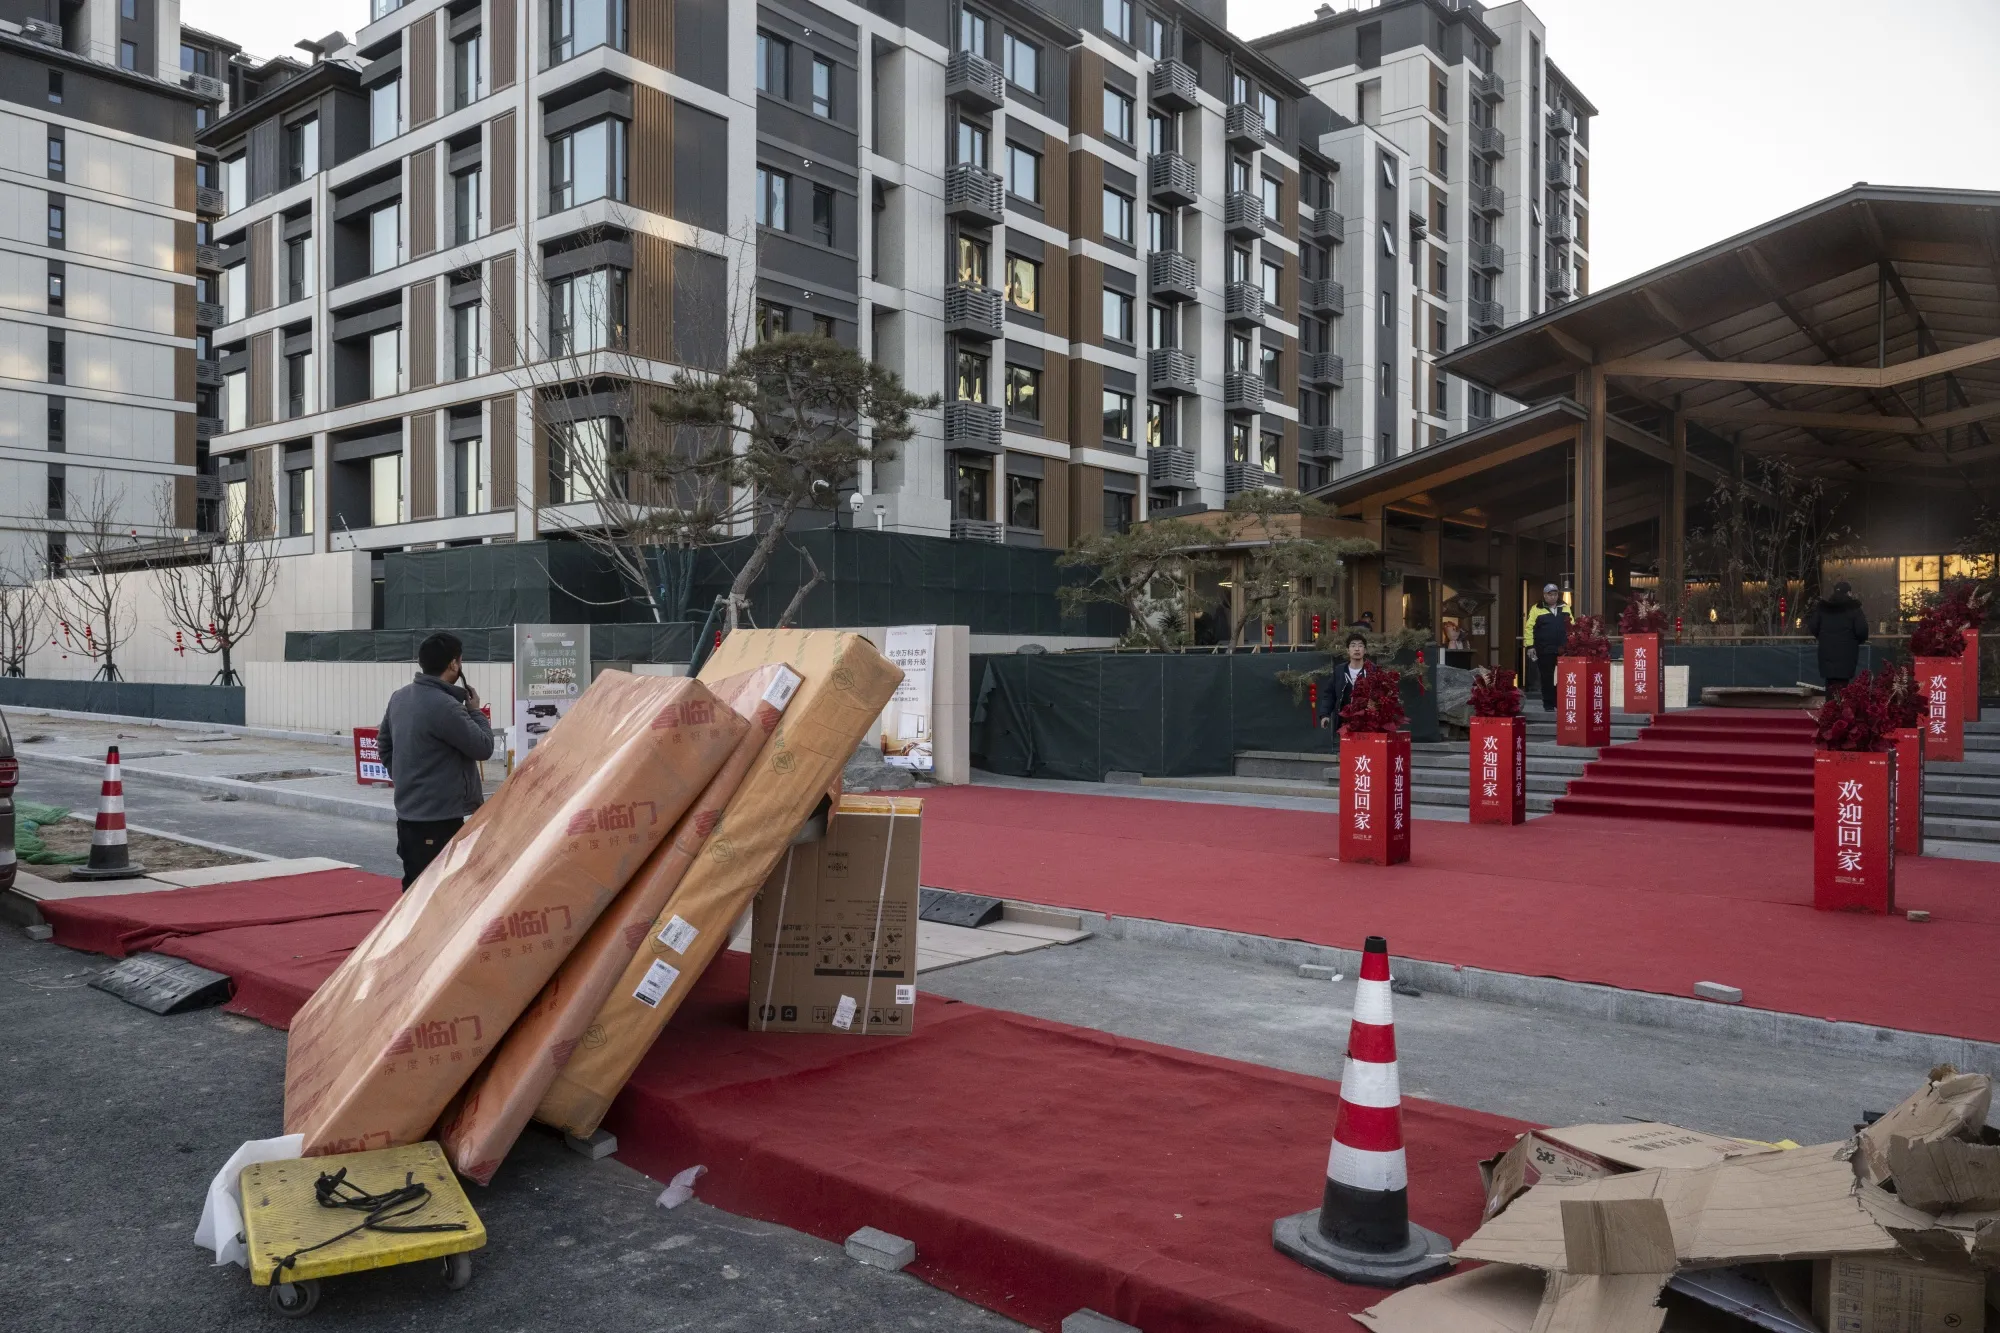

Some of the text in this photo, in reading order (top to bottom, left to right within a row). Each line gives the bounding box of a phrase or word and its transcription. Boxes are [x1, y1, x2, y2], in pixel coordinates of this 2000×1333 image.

[1566, 672, 1577, 724] 欢迎回家
[1593, 672, 1603, 724] 欢迎回家
[1634, 647, 1647, 694] 欢迎回家
[1929, 674, 1947, 735] 欢迎回家
[1354, 754, 1371, 830] 欢迎回家
[1394, 754, 1404, 830] 欢迎回家
[1483, 735, 1498, 797] 欢迎回家
[1837, 779, 1863, 872] 欢迎回家
